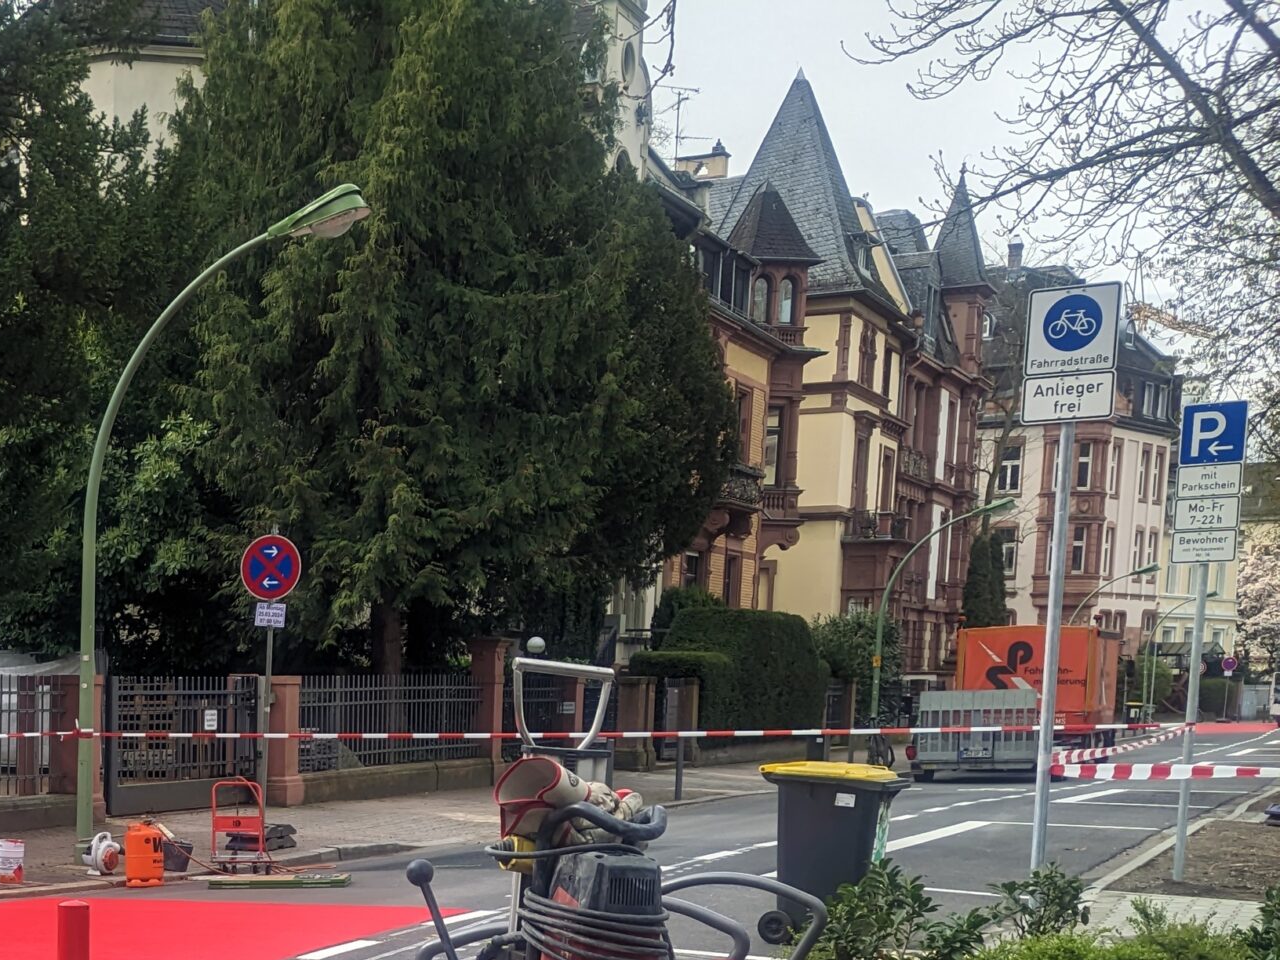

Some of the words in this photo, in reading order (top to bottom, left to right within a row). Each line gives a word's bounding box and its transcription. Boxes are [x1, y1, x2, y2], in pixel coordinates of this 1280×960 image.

[1030, 353, 1109, 369] Fahrradstraße
[1033, 380, 1104, 397] Anlieger
[1053, 399, 1081, 414] frei
[1190, 411, 1227, 458] P
[1201, 471, 1217, 480] mit
[1181, 479, 1236, 492] Parkschein
[1188, 502, 1225, 513] Mo-Fr
[1179, 536, 1229, 545] Bewohner
